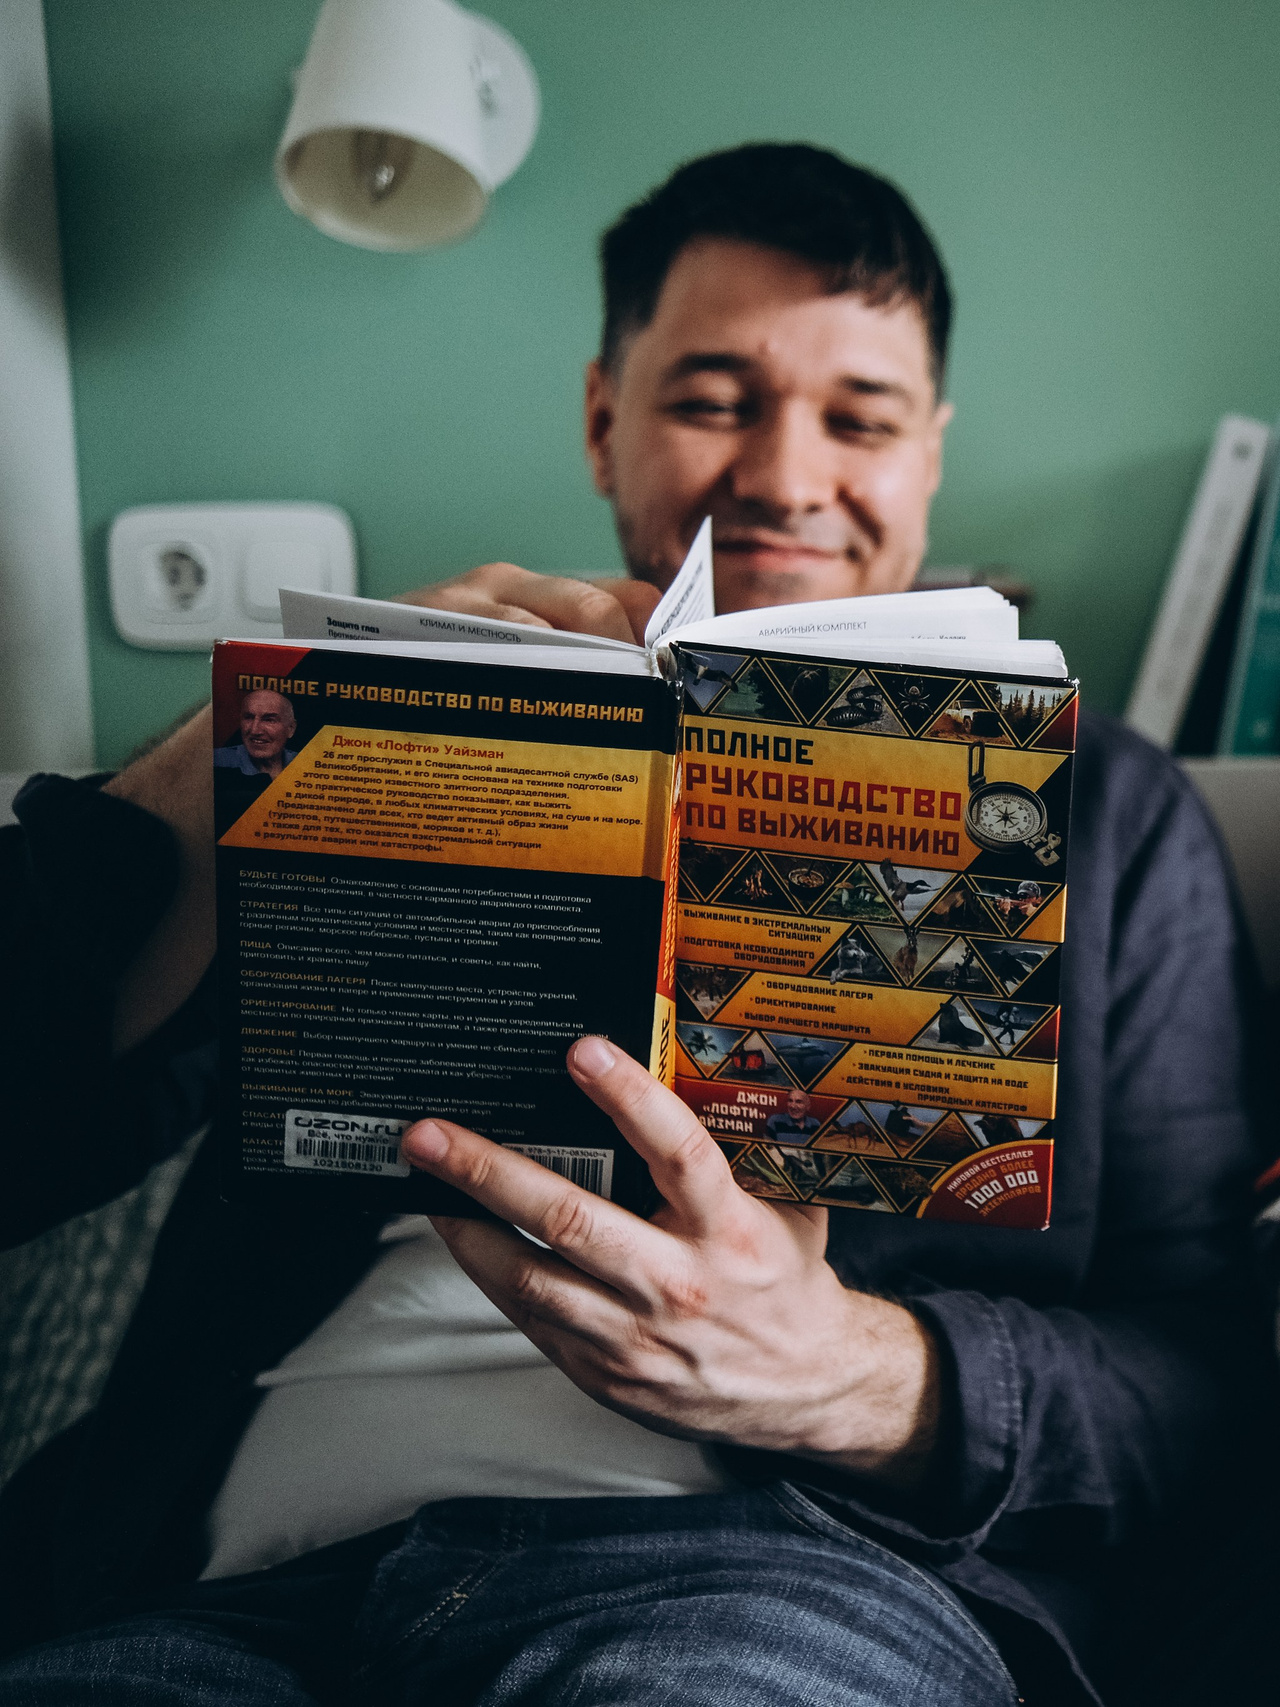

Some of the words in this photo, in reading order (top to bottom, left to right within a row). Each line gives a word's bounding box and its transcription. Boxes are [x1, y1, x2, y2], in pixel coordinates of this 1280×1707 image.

[326, 617, 360, 631] Защита
[361, 624, 380, 634] глаз
[419, 617, 456, 632] КЛИМАТ
[458, 624, 466, 633] И
[468, 626, 522, 643] МЕСТНОСТЬ
[758, 621, 815, 637] АВАРИЙНЫЙ
[816, 620, 867, 633] КОМПЛЕКТ
[238, 674, 318, 696] ПОЛНОЕ
[326, 682, 471, 709] РУКОВОДСТВО
[478, 695, 503, 711] ПО
[510, 698, 643, 722] ВЫЖИВАНИЮ
[332, 734, 371, 748] Джон
[376, 739, 439, 754] «Лофти»
[444, 744, 504, 759] Уайзман
[685, 725, 814, 766] ПОЛНОЕ
[314, 760, 401, 776] Великобритании,
[432, 772, 459, 780] книга
[462, 774, 509, 784] основана
[526, 779, 564, 788] технике
[566, 779, 622, 792] подготовки
[322, 750, 334, 759] 26
[356, 754, 413, 765] прослужил
[424, 759, 492, 772] Специальной
[495, 766, 570, 778] авиадесантной
[572, 772, 609, 781] службе
[611, 773, 638, 784] (SAS)
[294, 780, 313, 789] Это
[315, 783, 383, 795] практическое
[386, 789, 450, 800] руководство
[452, 795, 512, 806] показывает,
[533, 801, 571, 809] выжить
[303, 771, 330, 780] этого
[332, 774, 382, 784] всемирно
[384, 779, 441, 789] известного
[443, 783, 488, 793] элитного
[490, 787, 569, 799] подразделения.
[685, 762, 962, 822] РУКОВОДСТВО
[685, 801, 727, 831] ПО
[738, 808, 961, 857] ВЫЖИВАНИЮ
[239, 869, 277, 879] БУДЬТЕ
[239, 900, 298, 911] СТРАТЕГИЯ
[683, 908, 742, 923] ВЫЖИВАНИЕ
[744, 916, 750, 924] В
[752, 917, 830, 934] ЭКСТРЕМАЛЬНЫХ
[684, 936, 741, 950] ПОДГОТОВКА
[743, 943, 814, 959] НЕОБХОДИМОГО
[768, 929, 821, 943] СИТУАЦИЯХ
[734, 952, 805, 968] ОБОРУДОВАНИЯ
[766, 980, 837, 996] ОБОРУДОВАНИЕ
[838, 989, 873, 1000] ЛАГЕРЯ
[754, 996, 836, 1013] ОРИЕНТИРОВАНИЕ
[744, 1011, 775, 1022] ВЫБОР
[777, 1016, 819, 1028] ЛУЧШЕГО
[821, 1021, 870, 1034] МАРШРУТА
[868, 1049, 903, 1060] ПЕРВАЯ
[905, 1053, 944, 1065] ПОМОЩЬ
[954, 1058, 995, 1070] ЛЕЧЕНИЕ
[846, 1075, 892, 1088] ДЕЙСТВИЯ
[894, 1081, 900, 1089] В
[902, 1082, 949, 1094] УСЛОВИЯХ
[858, 1062, 910, 1075] ЭВАКУАЦИЯ
[912, 1068, 942, 1079] СУДНА
[944, 1072, 950, 1080] И
[952, 1073, 989, 1084] ЗАЩИТА
[1004, 1079, 1028, 1088] ВОДЕ
[736, 1090, 778, 1107] ДЖОН
[917, 1093, 973, 1106] ПРИРОДНЫХ
[974, 1100, 1027, 1112] КАТАСТРОФ
[703, 1102, 767, 1119] «ЛОФТИ»
[294, 1116, 403, 1137] OZON.ru
[698, 1115, 753, 1133] АЙЗМАН
[946, 1164, 981, 1193] МИРОВОЙ
[980, 1149, 1034, 1170] БЕСТСЕЛЛЕР
[954, 1168, 998, 1201] ПРОДАНО
[1000, 1160, 1036, 1175] БОЛЕЕ
[979, 1185, 1042, 1217] ЭКЗЕМПЛЯРОВ
